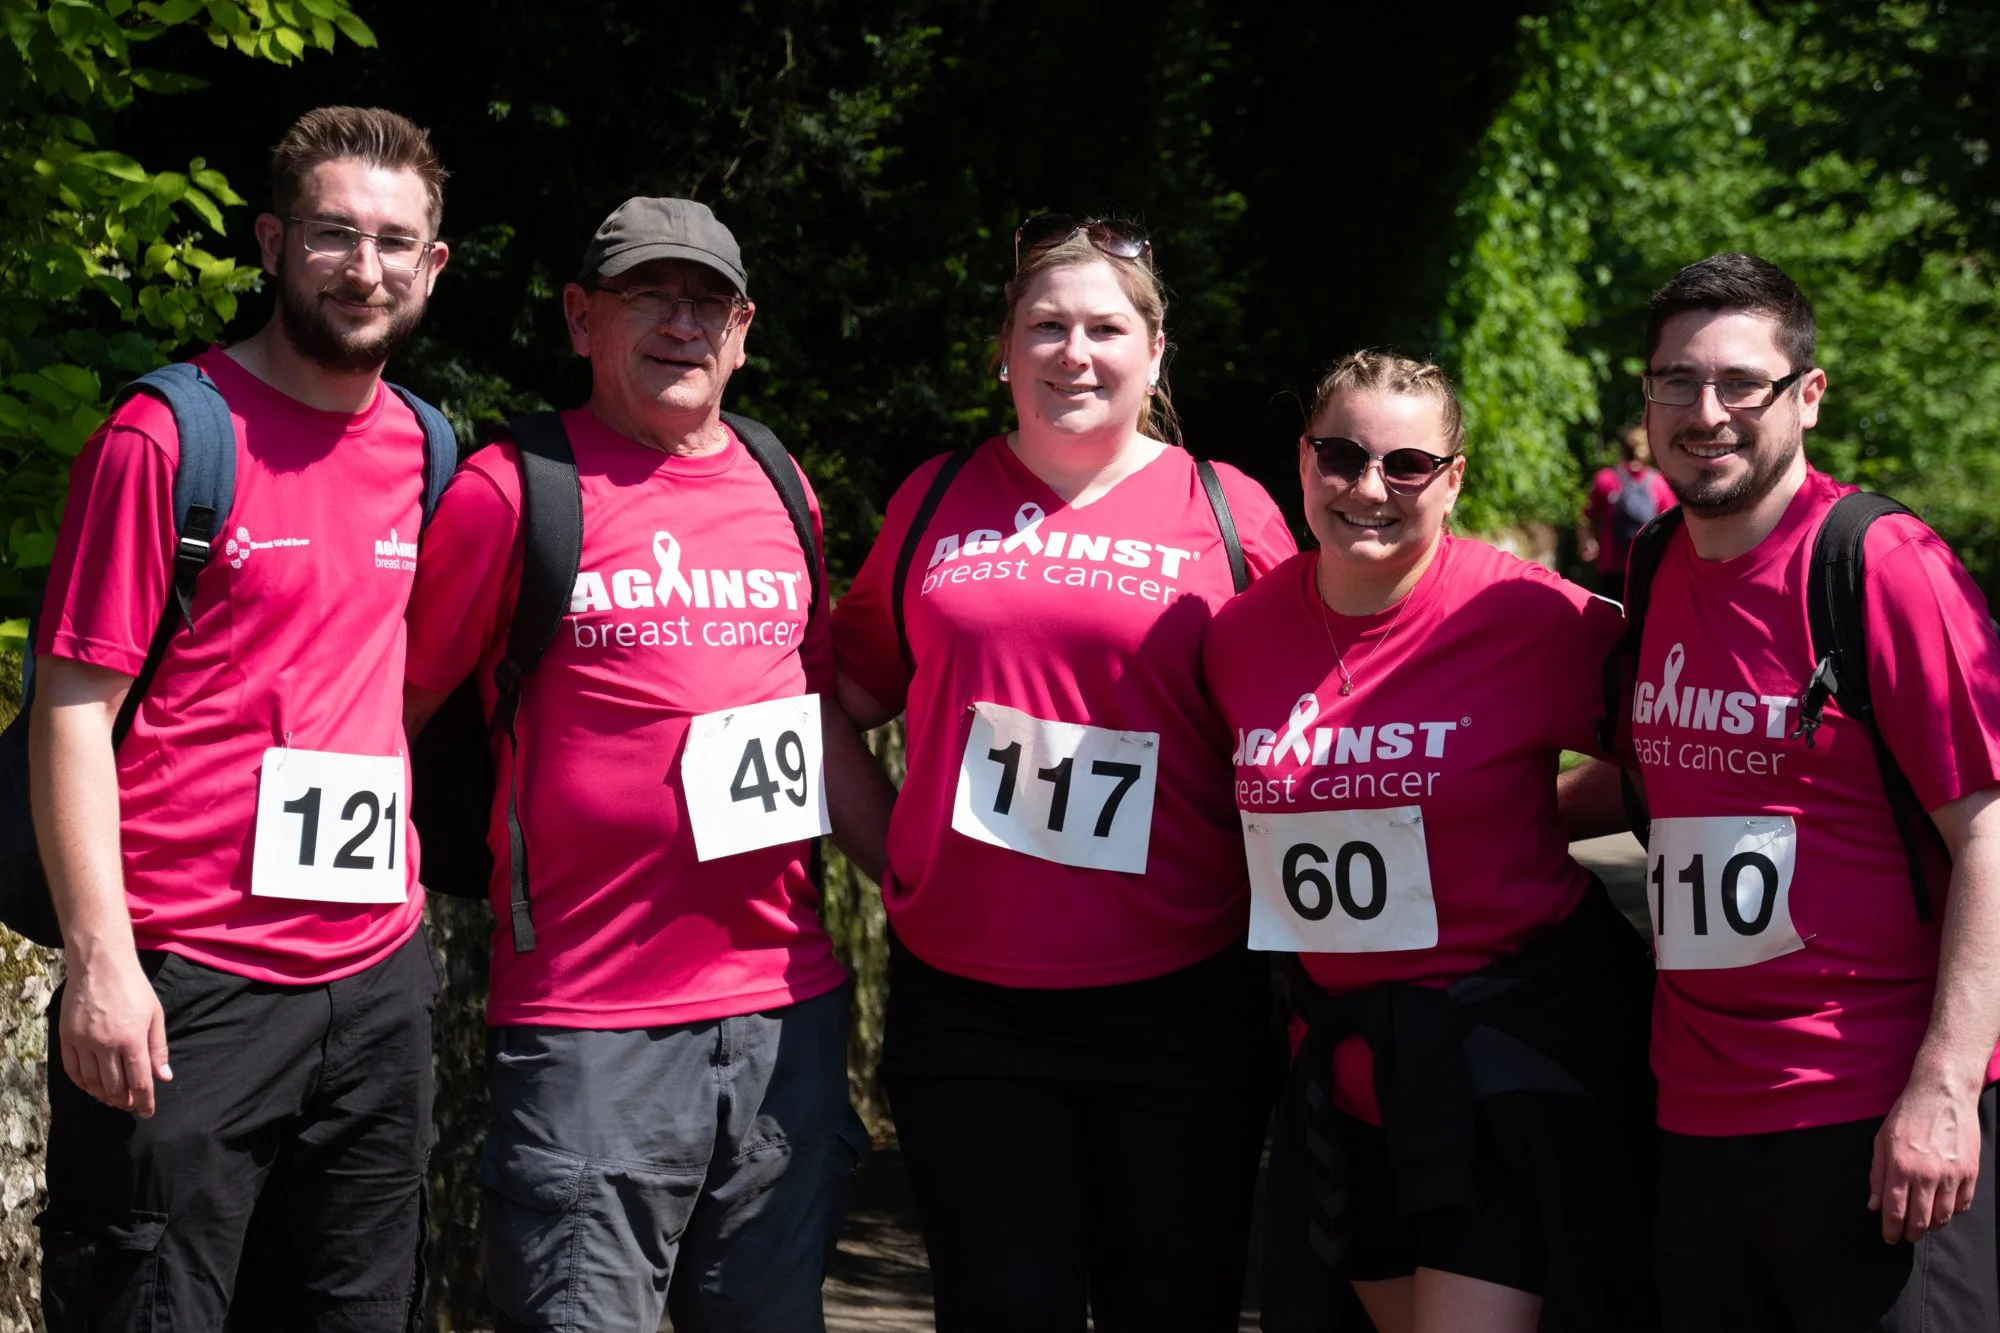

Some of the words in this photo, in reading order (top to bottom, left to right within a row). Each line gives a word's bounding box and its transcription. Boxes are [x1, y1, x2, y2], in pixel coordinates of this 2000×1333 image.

[375, 528, 417, 559] AGAINS
[921, 559, 1029, 596] breast
[1043, 564, 1177, 605] cancer
[572, 615, 693, 648] breast
[702, 620, 799, 647] cancer
[1631, 642, 1798, 739] GAINST
[730, 730, 807, 813] 49
[987, 741, 1141, 838] 117
[1235, 774, 1296, 805] reast
[1310, 771, 1440, 800] cancer
[1633, 736, 1671, 766] east
[1679, 743, 1786, 776] cancer
[283, 787, 396, 870] 121
[1282, 841, 1387, 921] 60
[1652, 852, 1779, 936] 110
